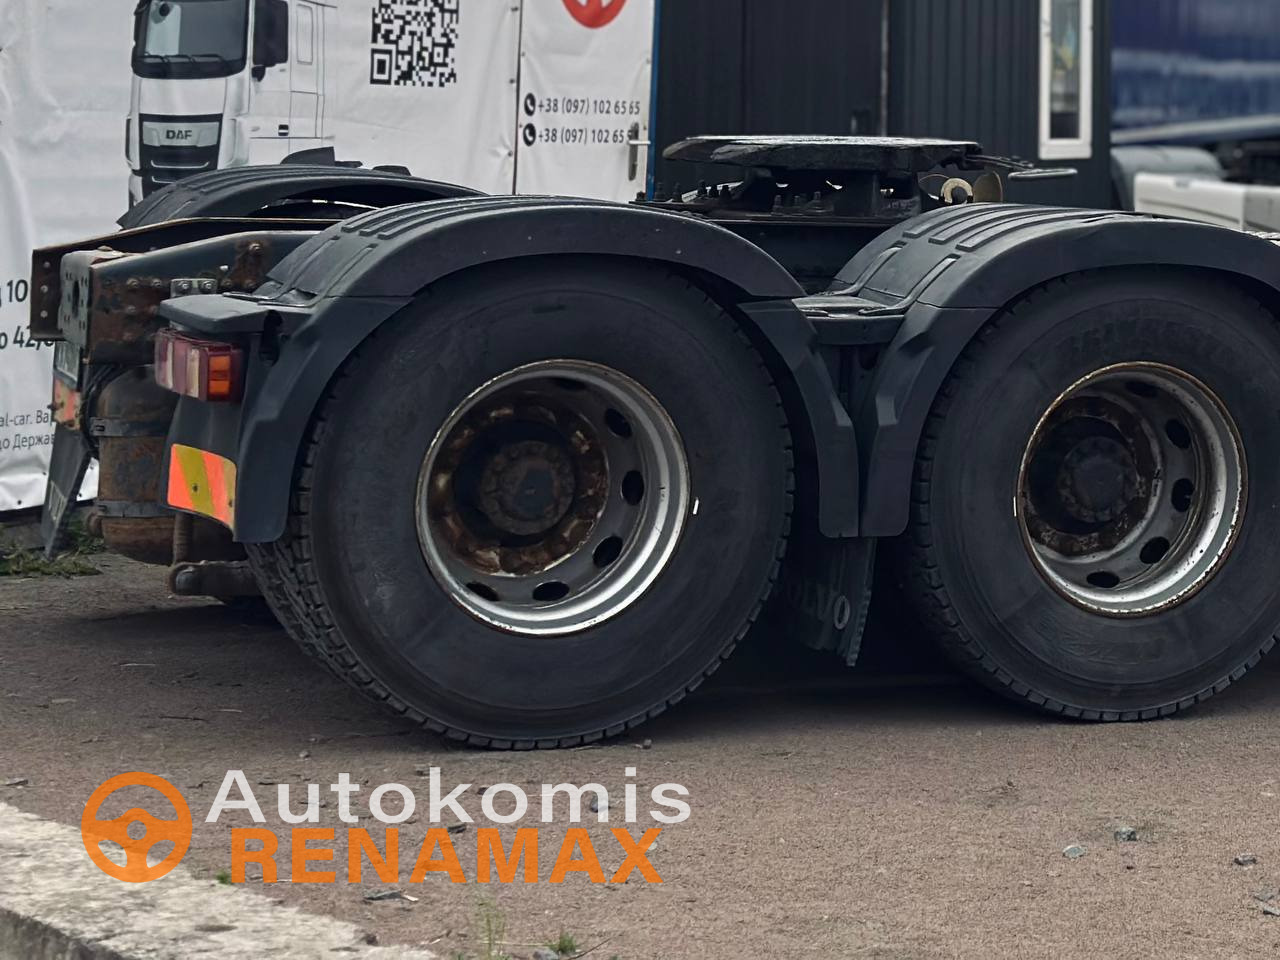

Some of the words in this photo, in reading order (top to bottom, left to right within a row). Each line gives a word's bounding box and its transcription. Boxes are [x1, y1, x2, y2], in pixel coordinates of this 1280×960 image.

[538, 98, 558, 113] +38
[562, 96, 590, 115] (097)
[593, 99, 611, 115] 102
[614, 100, 627, 115] 65
[628, 100, 640, 115] 65
[166, 129, 192, 140] DAF
[538, 127, 558, 143] +38
[560, 126, 588, 145] (097)
[592, 129, 610, 144] 102
[612, 129, 625, 144] 65
[7, 279, 28, 302] 10
